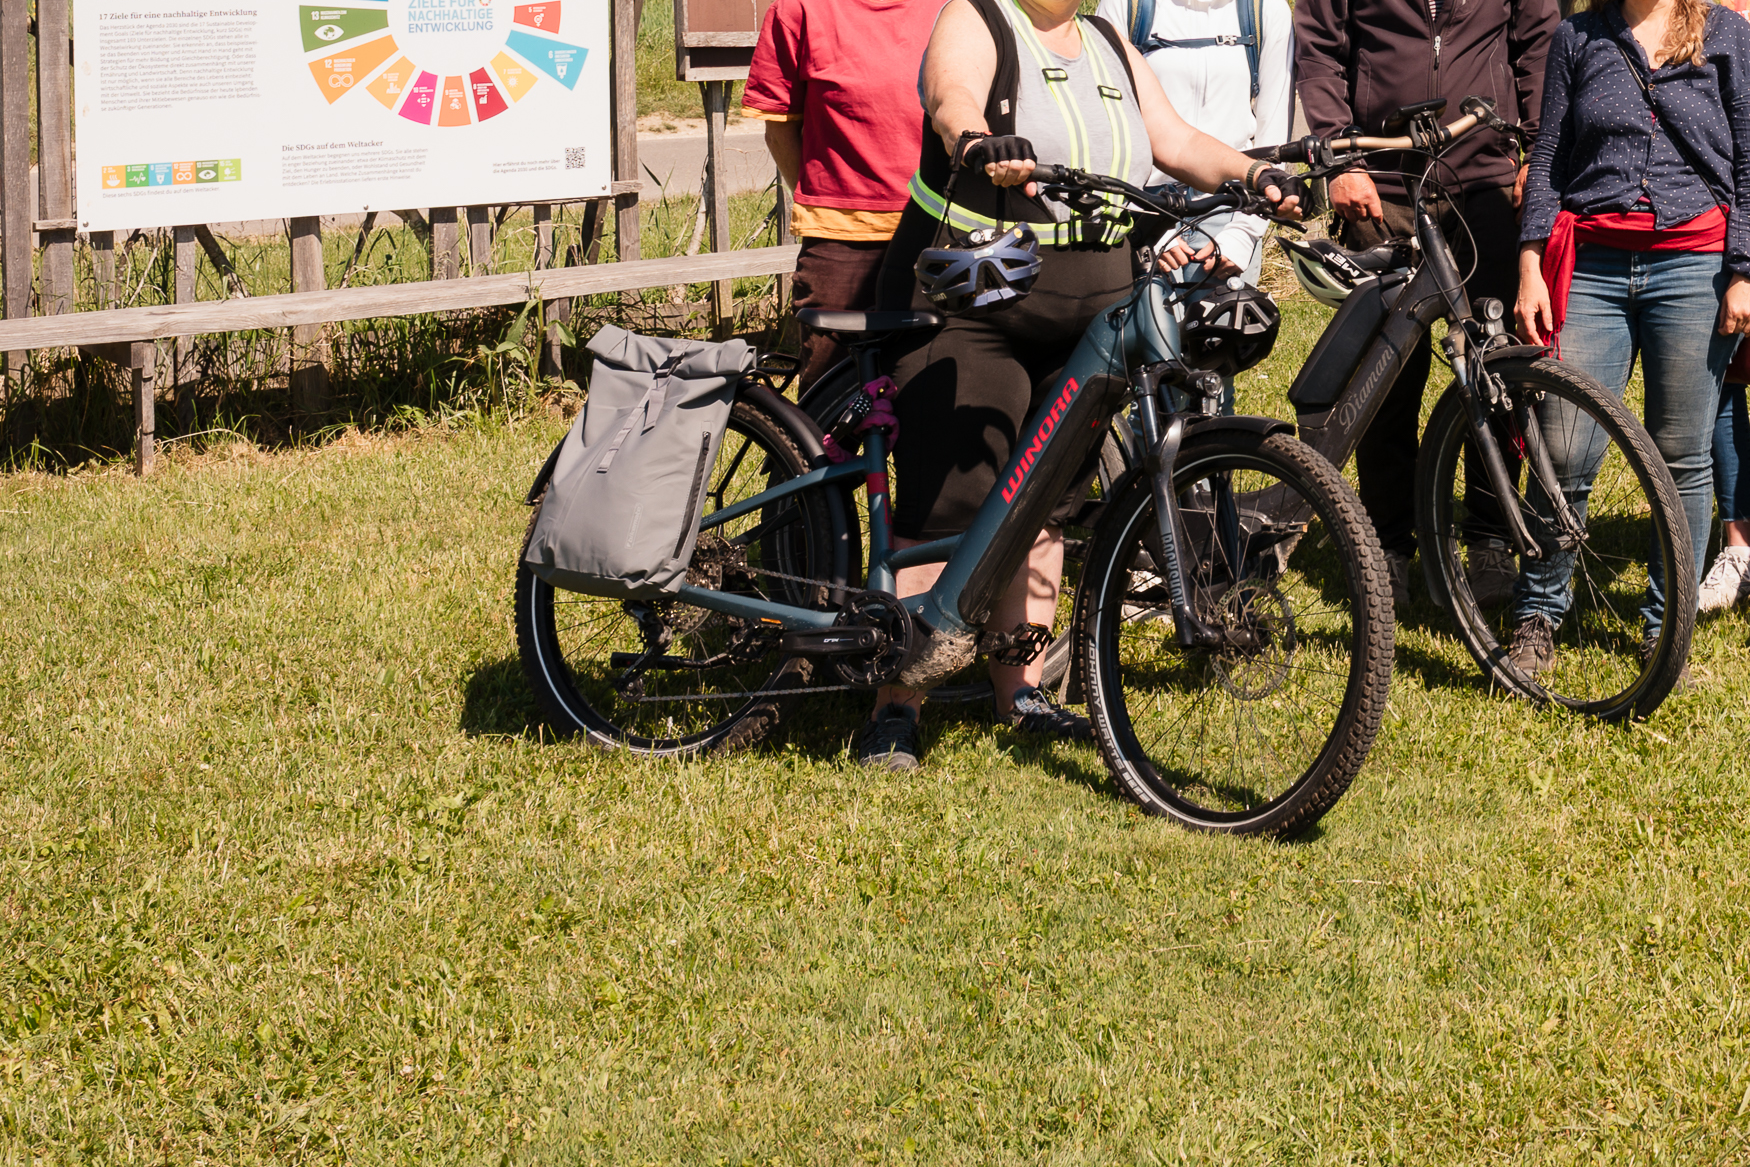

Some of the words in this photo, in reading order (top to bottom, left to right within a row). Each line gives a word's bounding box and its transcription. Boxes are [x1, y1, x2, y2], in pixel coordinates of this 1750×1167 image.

[163, 10, 208, 19] nachhaltige
[209, 9, 257, 17] Entwicklung
[311, 11, 320, 20] 13
[408, 8, 493, 21] NACHHALTIGE
[408, 21, 493, 33] ENTWICKLUNG
[548, 51, 553, 59] 6
[324, 59, 332, 68] 12
[347, 140, 384, 148] Weltacker
[1324, 252, 1360, 278] MET
[1001, 377, 1079, 505] WINORA
